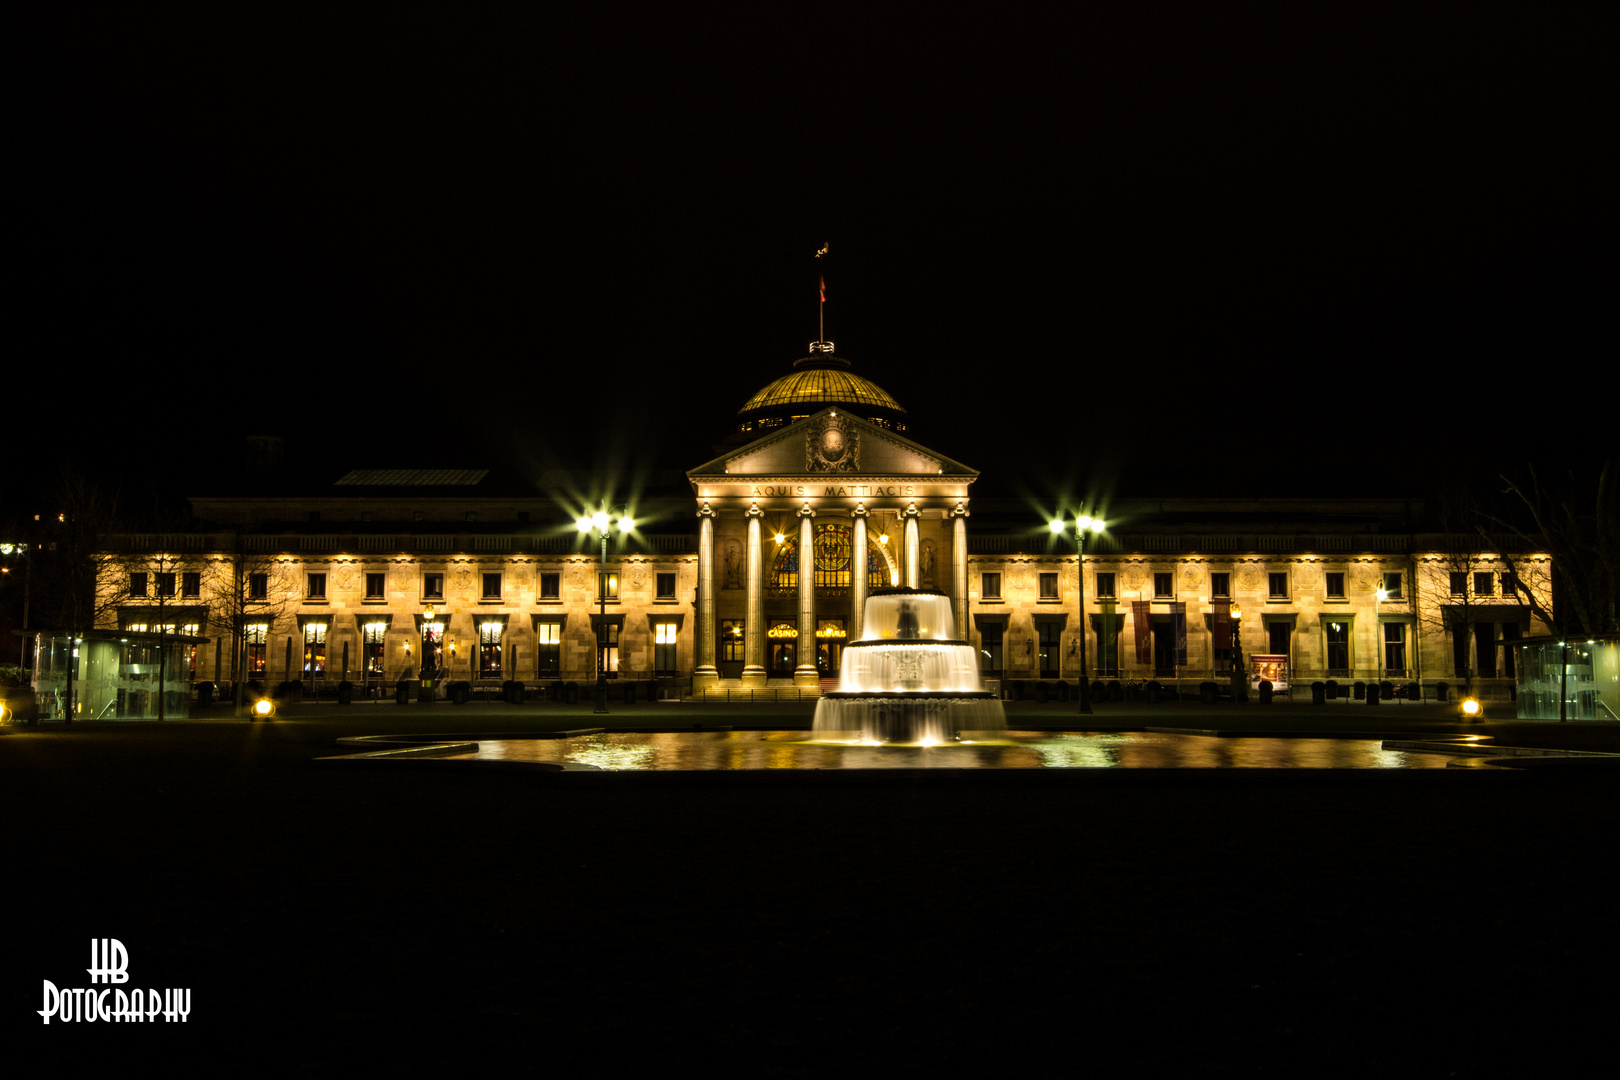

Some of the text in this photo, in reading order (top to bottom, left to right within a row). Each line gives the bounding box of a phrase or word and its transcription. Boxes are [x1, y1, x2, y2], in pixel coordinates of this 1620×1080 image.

[752, 486, 915, 496] AQUIS MATTIACIS
[768, 629, 798, 638] CASINO
